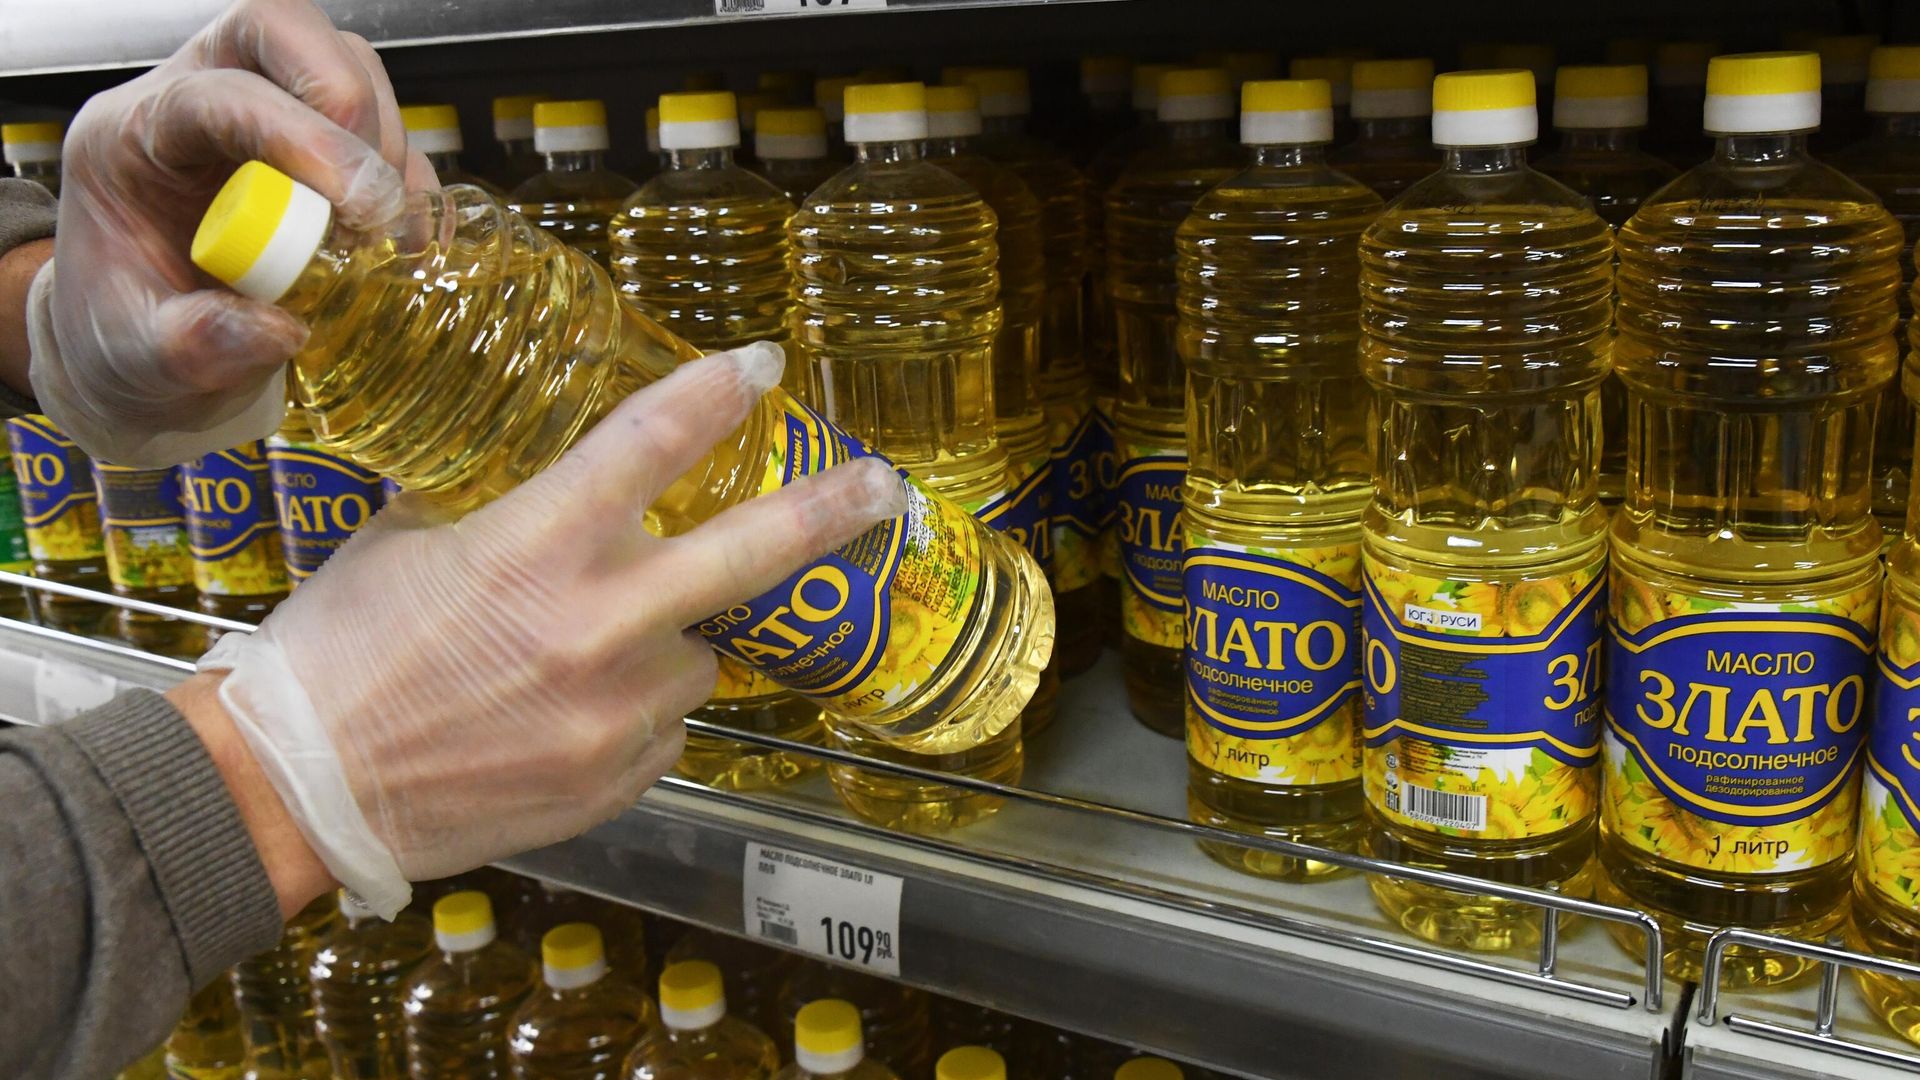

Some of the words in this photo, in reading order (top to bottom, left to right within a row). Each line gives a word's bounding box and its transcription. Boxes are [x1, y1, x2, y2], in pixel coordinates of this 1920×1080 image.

[793, 437, 804, 481] ТАМИН
[185, 475, 252, 514] АТО
[273, 491, 370, 533] АТО
[1202, 579, 1280, 611] МАСЛО
[700, 605, 752, 637] СЛО
[730, 564, 850, 667] АТО
[1408, 609, 1426, 621] ЮГ
[1440, 615, 1477, 628] РУСИ
[1191, 658, 1314, 694] подсолнечное
[1707, 650, 1815, 676] МАСЛО
[1635, 669, 1865, 744] ЗЛАТО
[1226, 748, 1271, 770] литр
[1668, 743, 1839, 771] подсолнечное
[1705, 784, 1804, 797] дезодорированное
[1706, 774, 1805, 787] рафинированное
[1711, 835, 1722, 857] 1
[1733, 839, 1789, 858] литр
[821, 917, 874, 965] 109
[876, 930, 891, 949] 90
